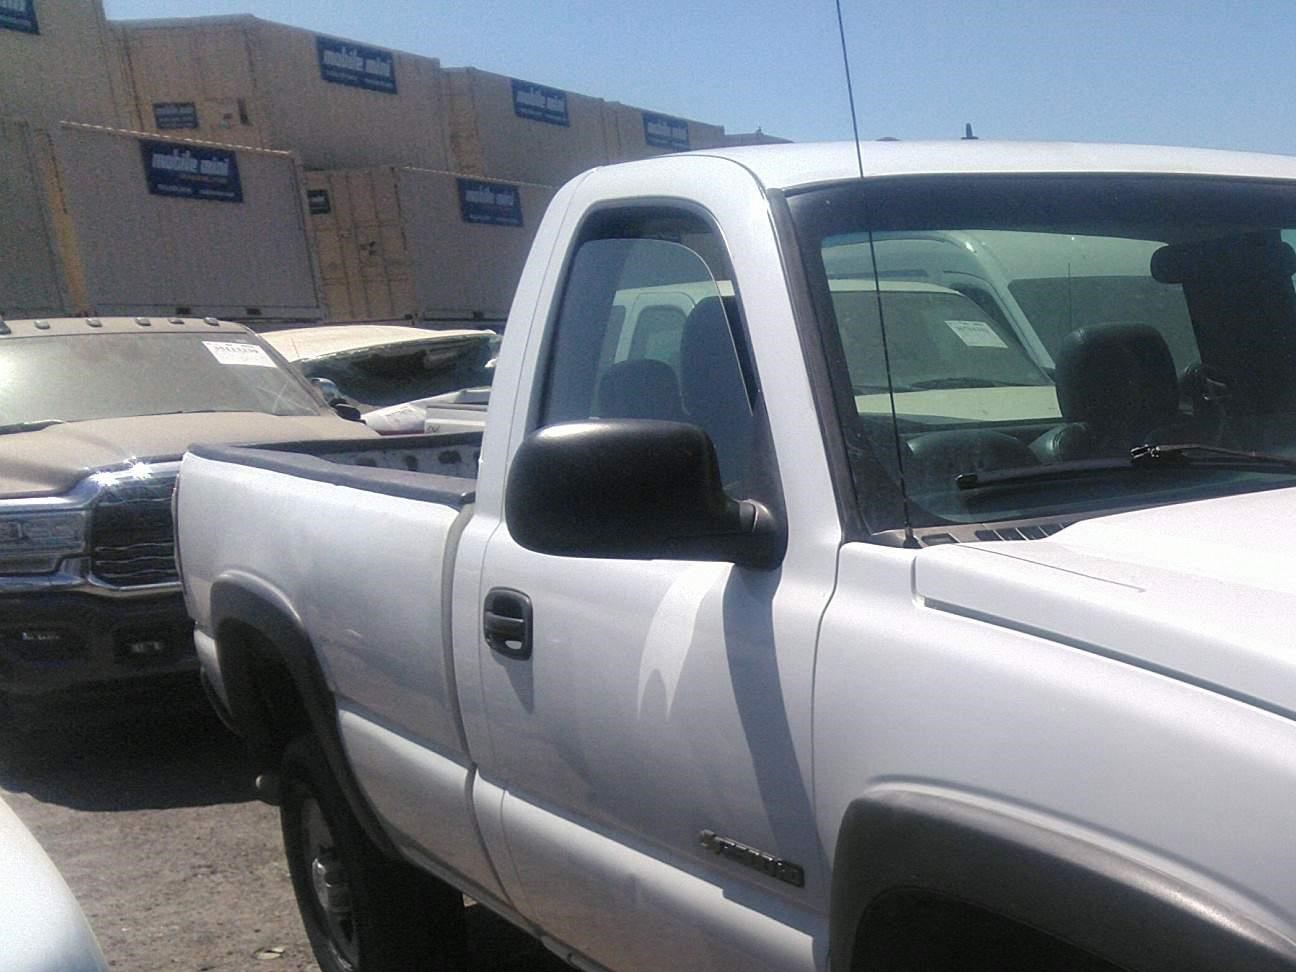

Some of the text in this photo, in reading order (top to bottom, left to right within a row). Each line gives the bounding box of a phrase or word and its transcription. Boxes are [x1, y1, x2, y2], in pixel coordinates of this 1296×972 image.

[324, 46, 391, 77] mobile mini
[152, 150, 229, 177] mobile mini
